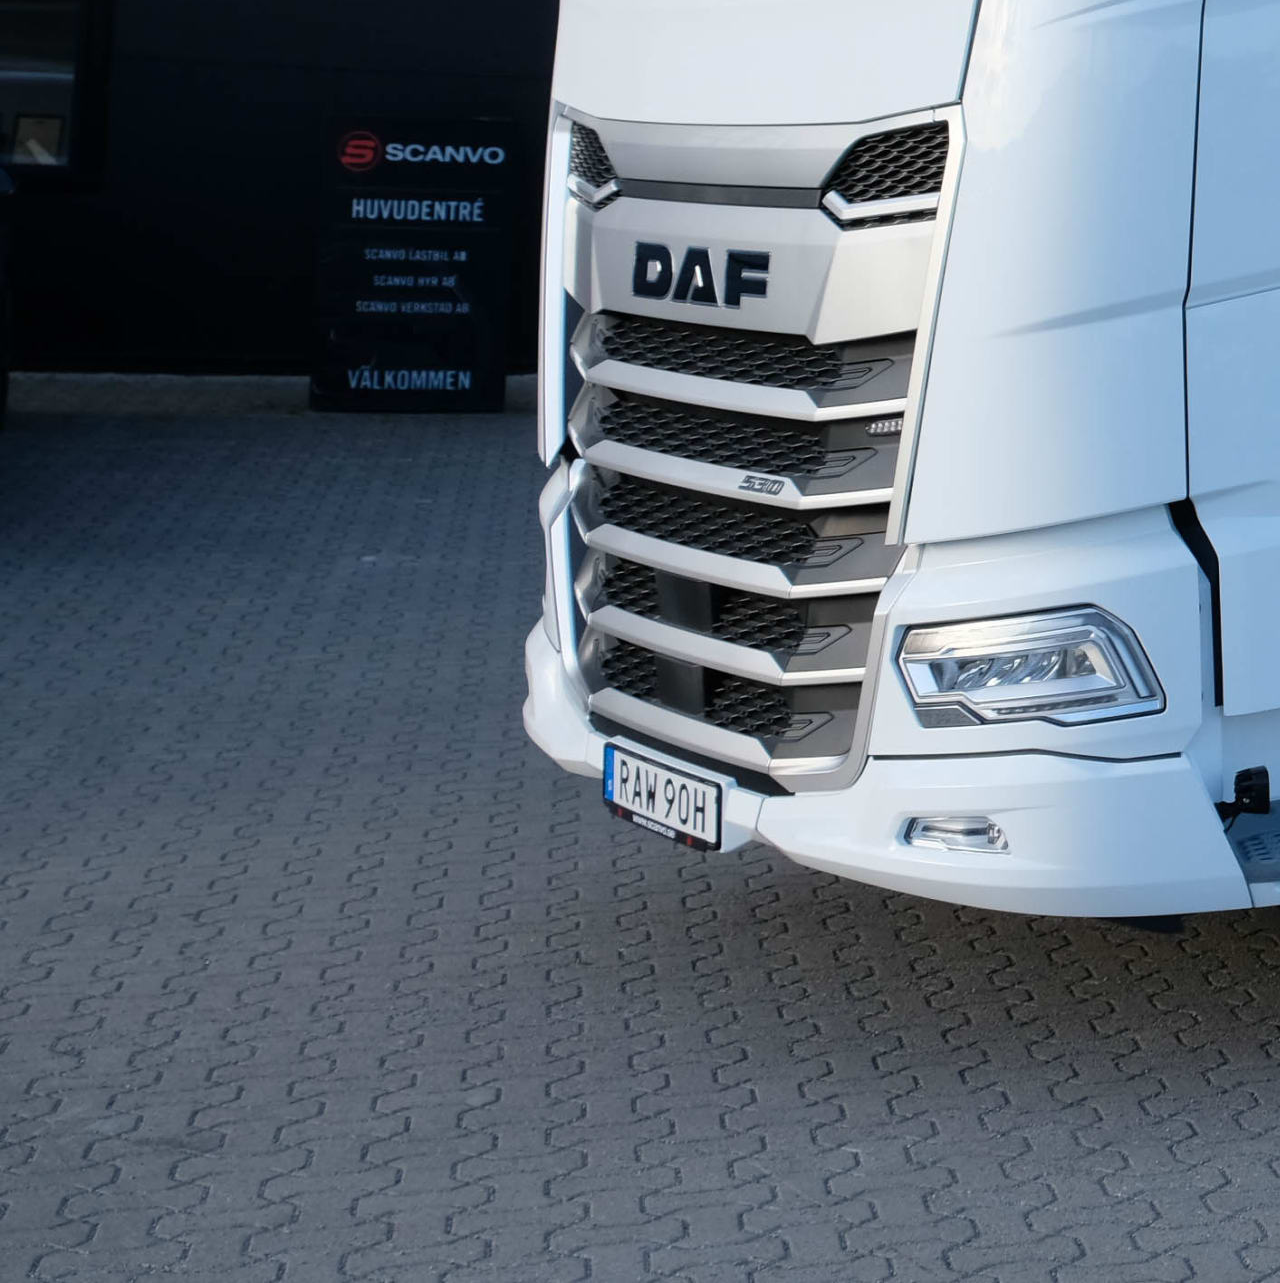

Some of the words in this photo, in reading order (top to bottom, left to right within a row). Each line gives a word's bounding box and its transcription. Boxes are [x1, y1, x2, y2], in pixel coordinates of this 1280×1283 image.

[385, 142, 505, 165] SCANVO
[351, 197, 485, 222] HUVUDENTRÉ
[363, 247, 406, 261] SCANVO
[372, 274, 414, 287] SCANVO
[632, 241, 771, 309] DAF
[355, 300, 397, 314] SCANVO
[347, 366, 472, 391] VÄLKOMMEN
[738, 475, 785, 496] 530
[619, 759, 657, 814] RAW
[664, 778, 705, 834] 90H
